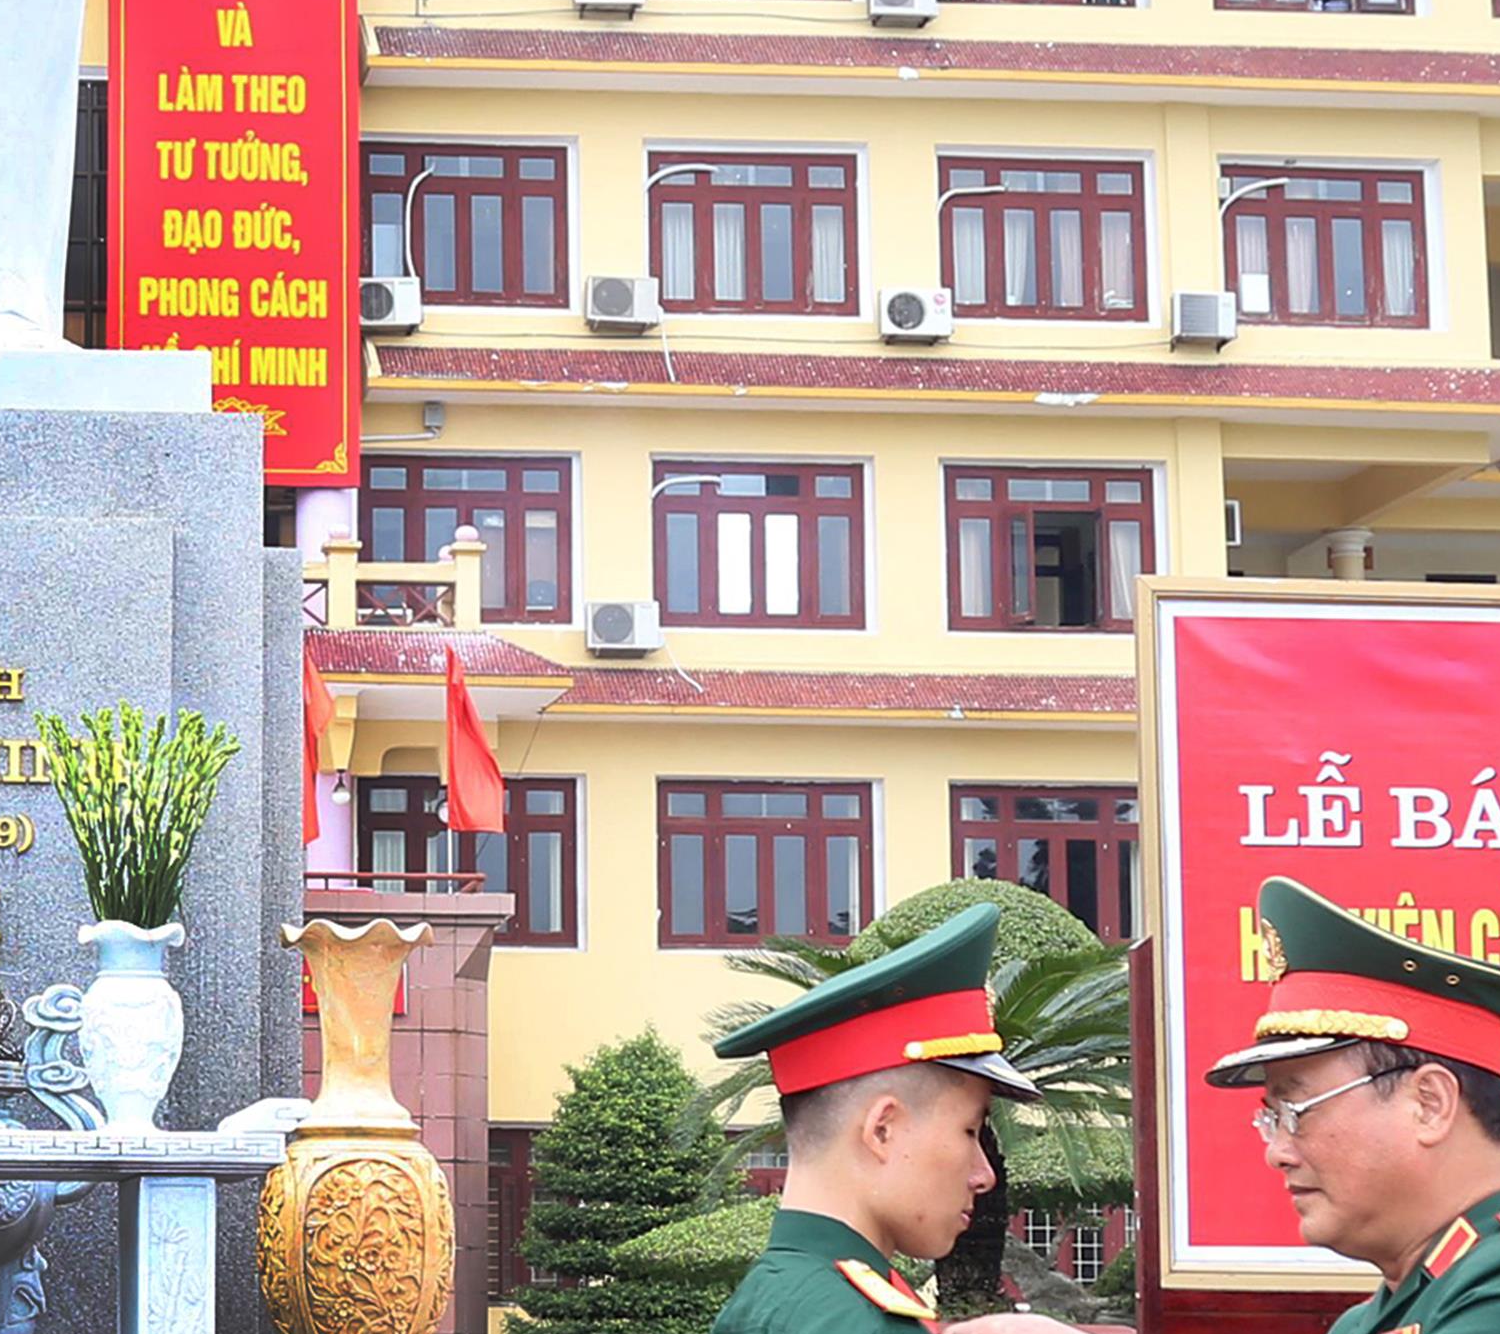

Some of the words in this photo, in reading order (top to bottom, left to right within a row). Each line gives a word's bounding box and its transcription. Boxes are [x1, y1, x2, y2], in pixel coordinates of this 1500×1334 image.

[216, 1, 254, 48] VÀ
[157, 65, 223, 113] LÀM
[231, 74, 307, 115] THEO
[155, 138, 197, 181] TƯ
[202, 130, 309, 187] TƯỞNG,
[163, 209, 222, 255] ĐẠO
[232, 202, 302, 255] ĐỨC,
[138, 276, 240, 318] PHONG
[250, 271, 329, 319] CÁCH
[194, 338, 241, 386] HÍ
[249, 346, 329, 387] MINH
[1238, 750, 1363, 848] LỄ
